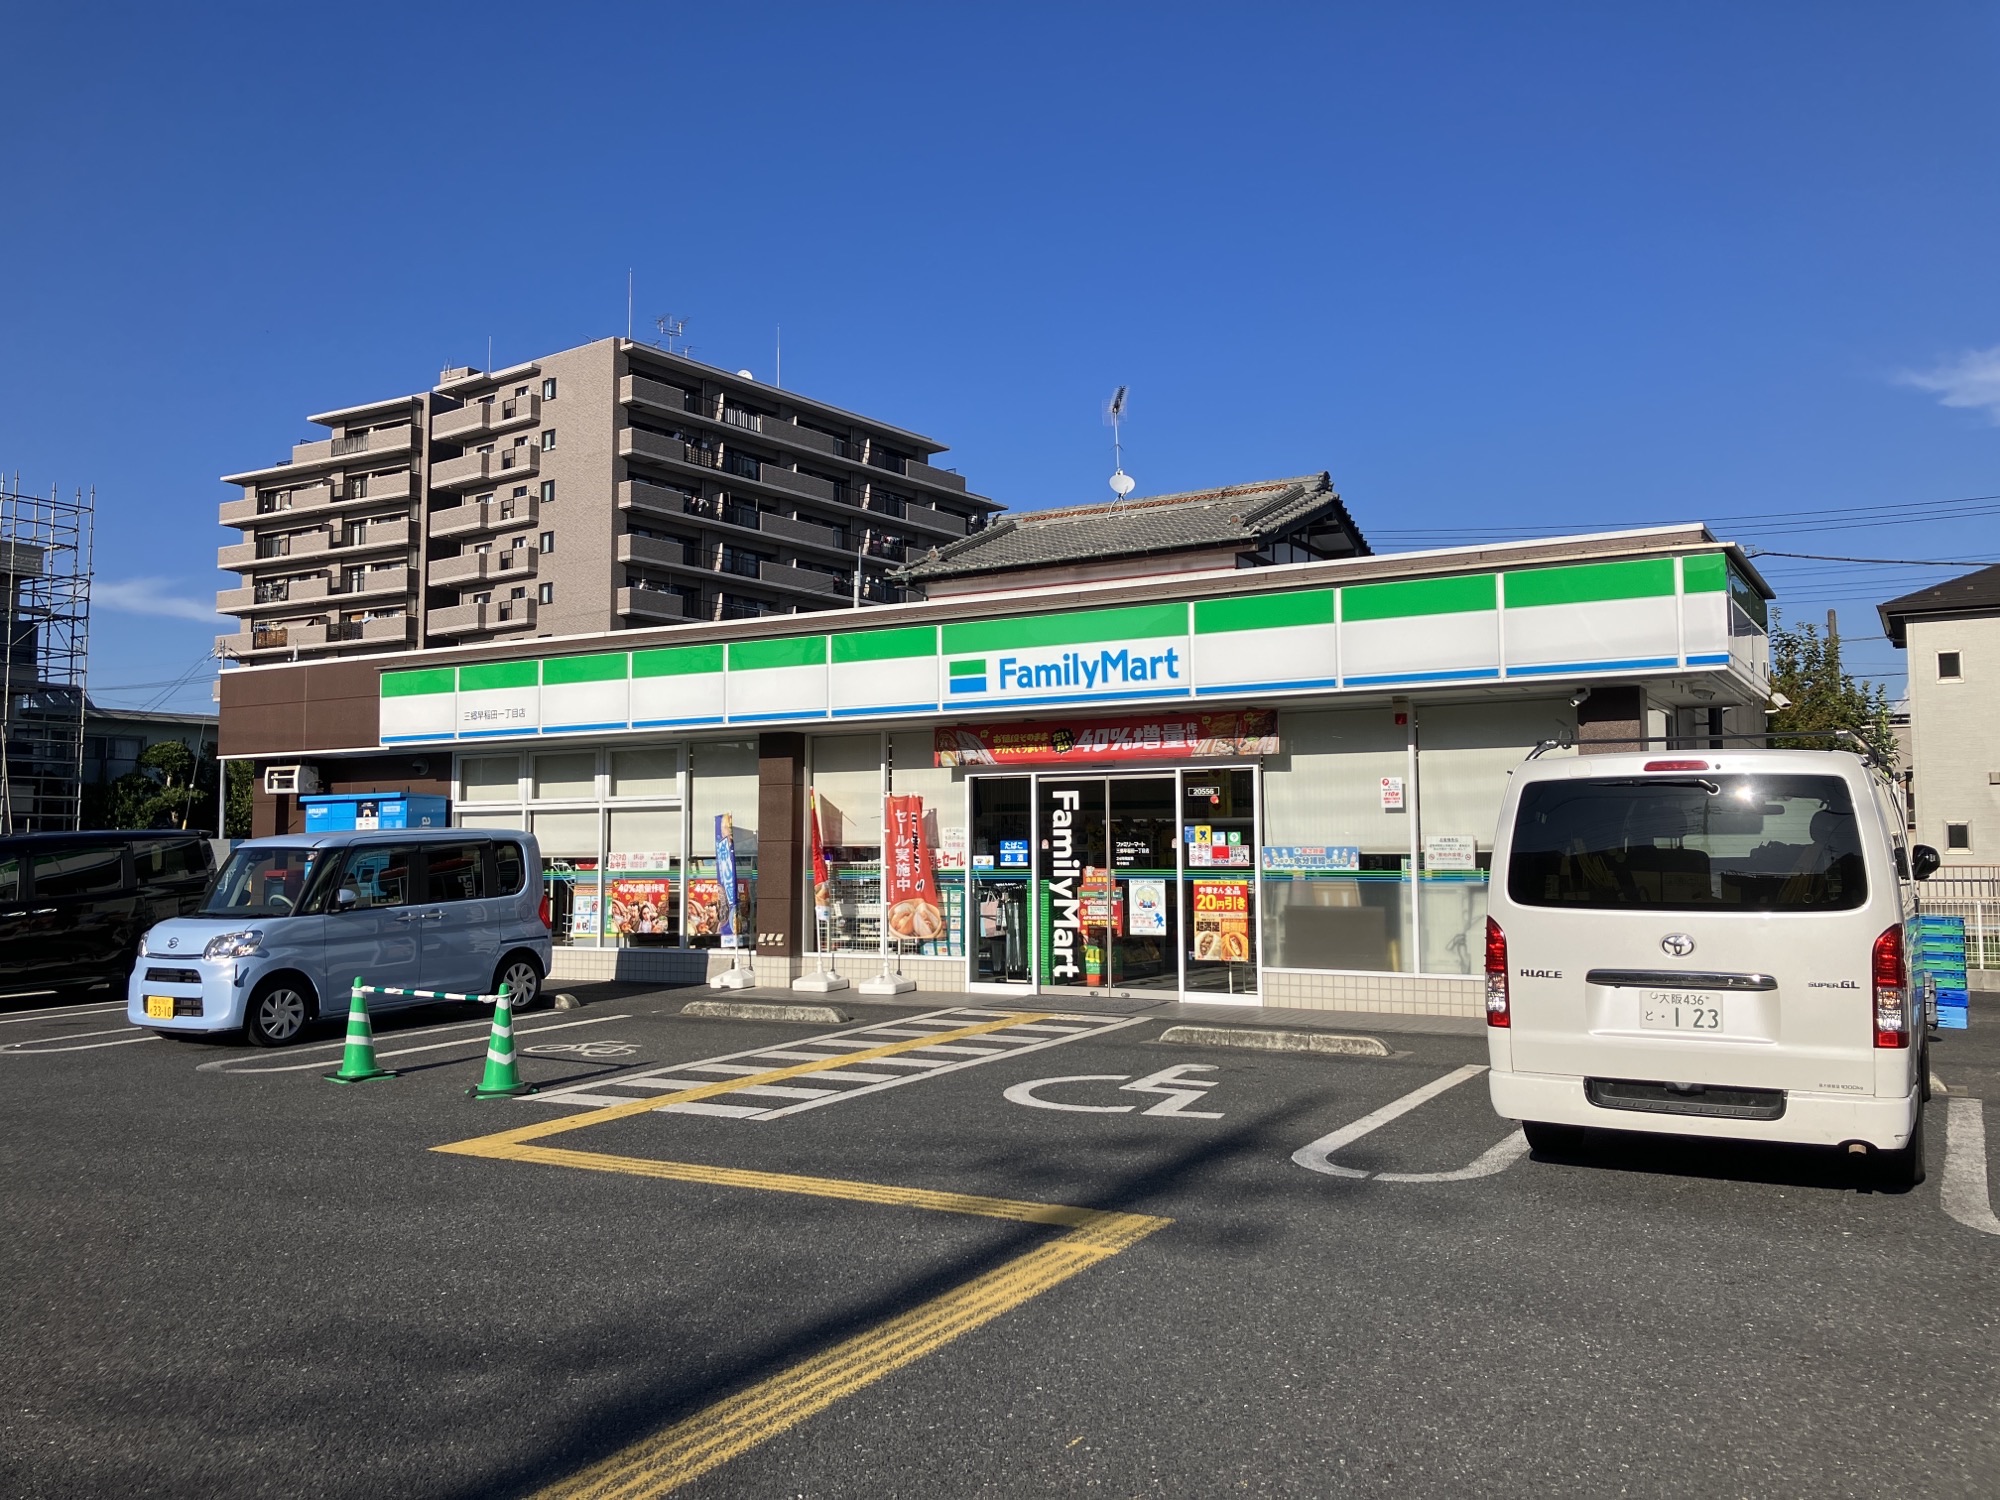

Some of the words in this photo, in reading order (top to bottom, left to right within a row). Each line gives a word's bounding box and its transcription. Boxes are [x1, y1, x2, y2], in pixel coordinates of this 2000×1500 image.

[999, 647, 1180, 690] FamilyMart
[463, 708, 526, 721] 三郷早稲田一丁目店
[993, 732, 1048, 743] お値段そのまま
[308, 807, 328, 815] amazon
[894, 809, 911, 892] セール実施中
[609, 861, 627, 869] お中元
[1049, 790, 1081, 978] FamilyMart
[1198, 885, 1241, 896] 中華まん全品
[1196, 894, 1246, 911] 20円引き
[1520, 969, 1563, 979] HIACE
[1840, 980, 1861, 989] GL
